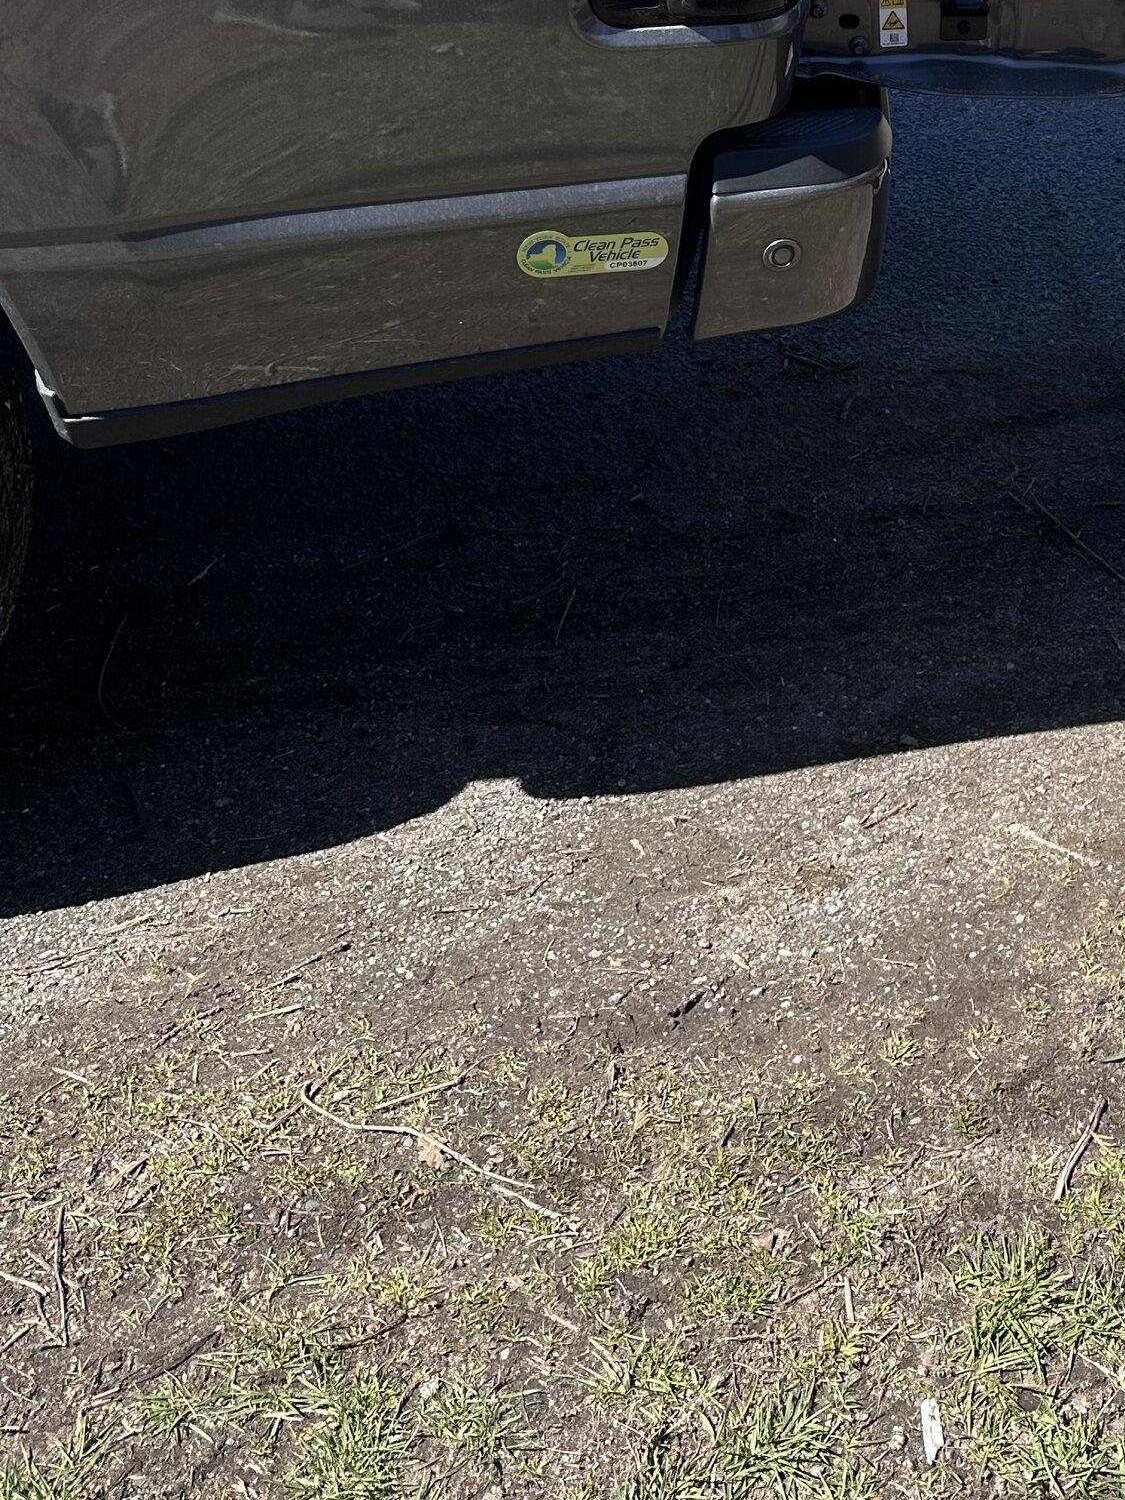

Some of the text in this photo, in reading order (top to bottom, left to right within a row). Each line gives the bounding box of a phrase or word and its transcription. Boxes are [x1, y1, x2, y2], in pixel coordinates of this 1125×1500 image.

[573, 239, 616, 252] Clean
[620, 237, 660, 249] Pass
[590, 248, 641, 262] Vehicle
